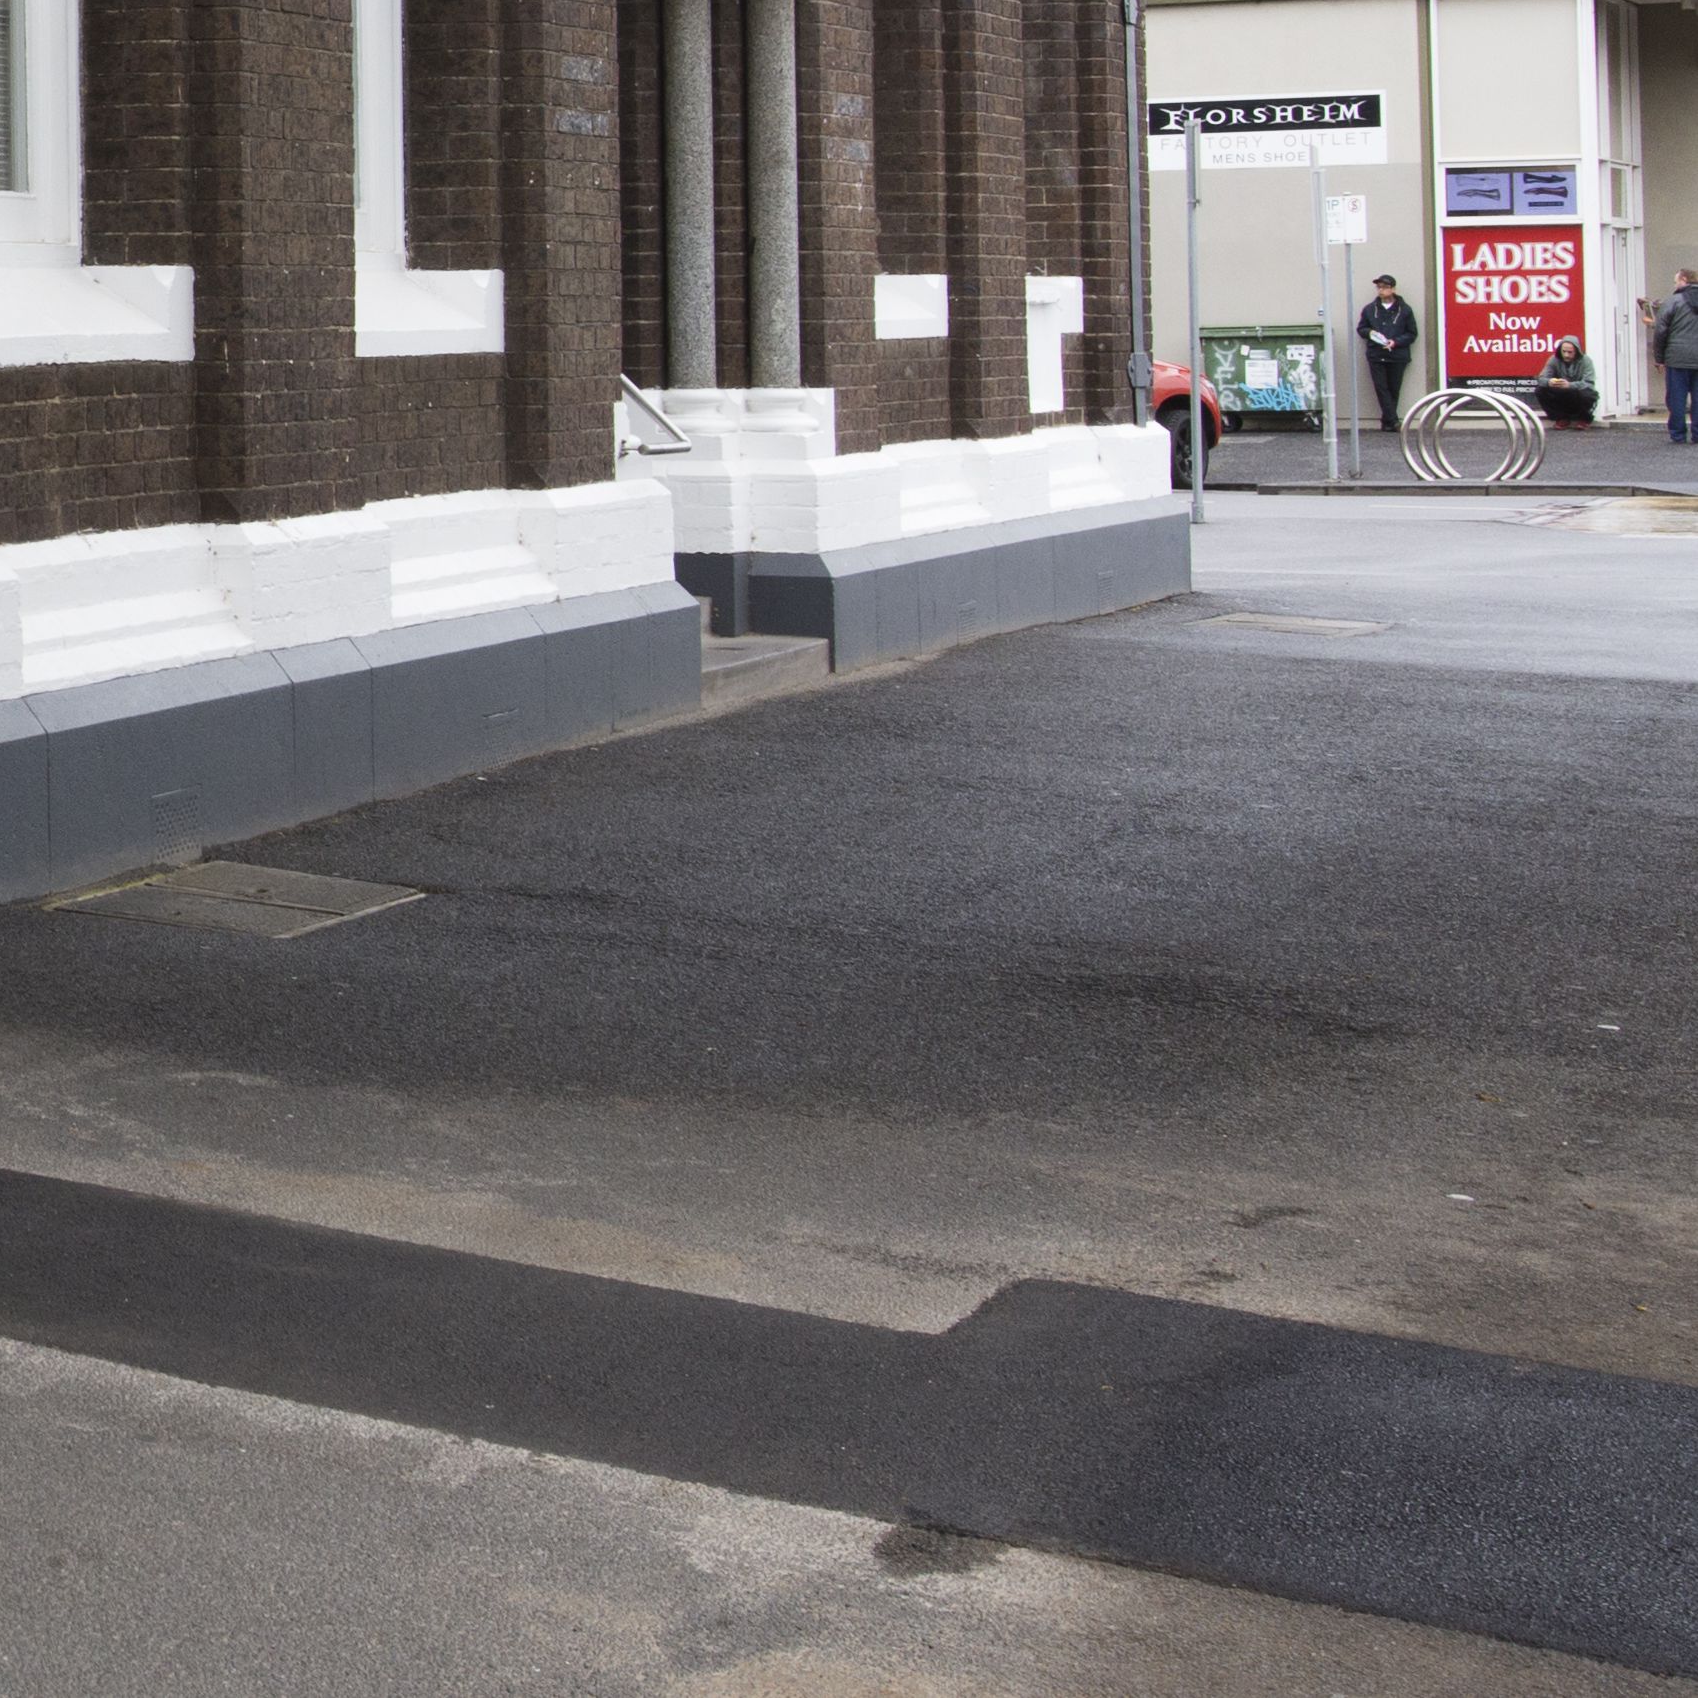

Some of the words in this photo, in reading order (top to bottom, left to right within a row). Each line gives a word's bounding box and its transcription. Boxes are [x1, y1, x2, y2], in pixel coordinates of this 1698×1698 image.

[1159, 99, 1368, 131] FLORSHEIM
[1160, 135, 1264, 151] FATORY
[1283, 131, 1371, 148] OUTLET
[1212, 153, 1257, 165] MENS
[1263, 151, 1307, 163] SHOE
[1326, 199, 1340, 210] 1P
[1450, 241, 1575, 271] LADIES
[1455, 274, 1571, 304] SHOES
[1489, 312, 1541, 330] Now
